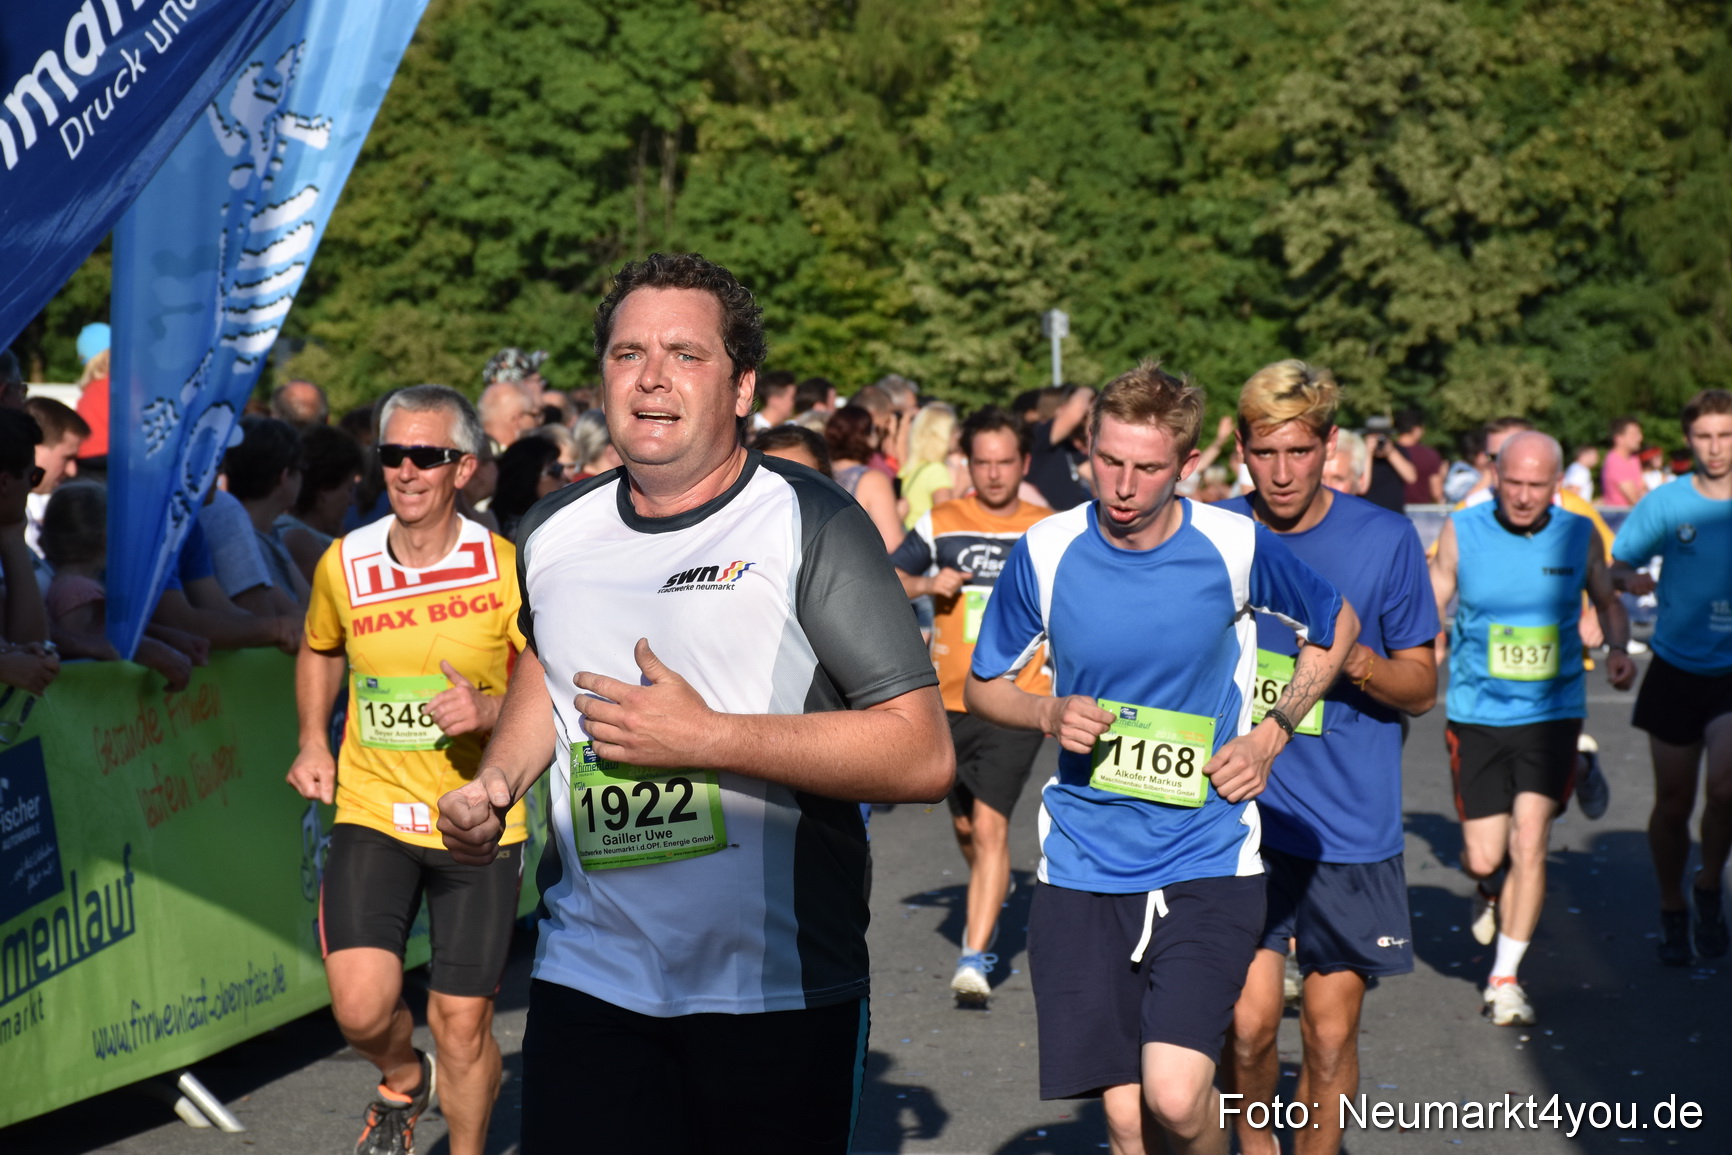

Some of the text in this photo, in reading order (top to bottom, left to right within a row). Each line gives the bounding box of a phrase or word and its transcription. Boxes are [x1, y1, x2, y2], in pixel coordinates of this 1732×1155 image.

[60, 49, 147, 160] Druck
[662, 565, 719, 588] swn
[695, 583, 735, 591] neumarkt
[352, 592, 504, 637] MAX BÖGL
[1499, 644, 1552, 664] 1937
[365, 701, 434, 728] 1348
[1108, 736, 1195, 778] 1168
[1100, 775, 1142, 789] Maschinenbau
[1143, 783, 1175, 794] Silberhorn
[1176, 789, 1195, 797] GmbH
[1115, 769, 1182, 788] Alkofer Markus
[0, 795, 40, 834] ischer
[581, 777, 698, 833] 1922
[602, 829, 673, 846] Gailler Uwe
[603, 845, 635, 855] Neumarkt
[663, 838, 690, 849] Energie
[692, 834, 715, 844] GmbH
